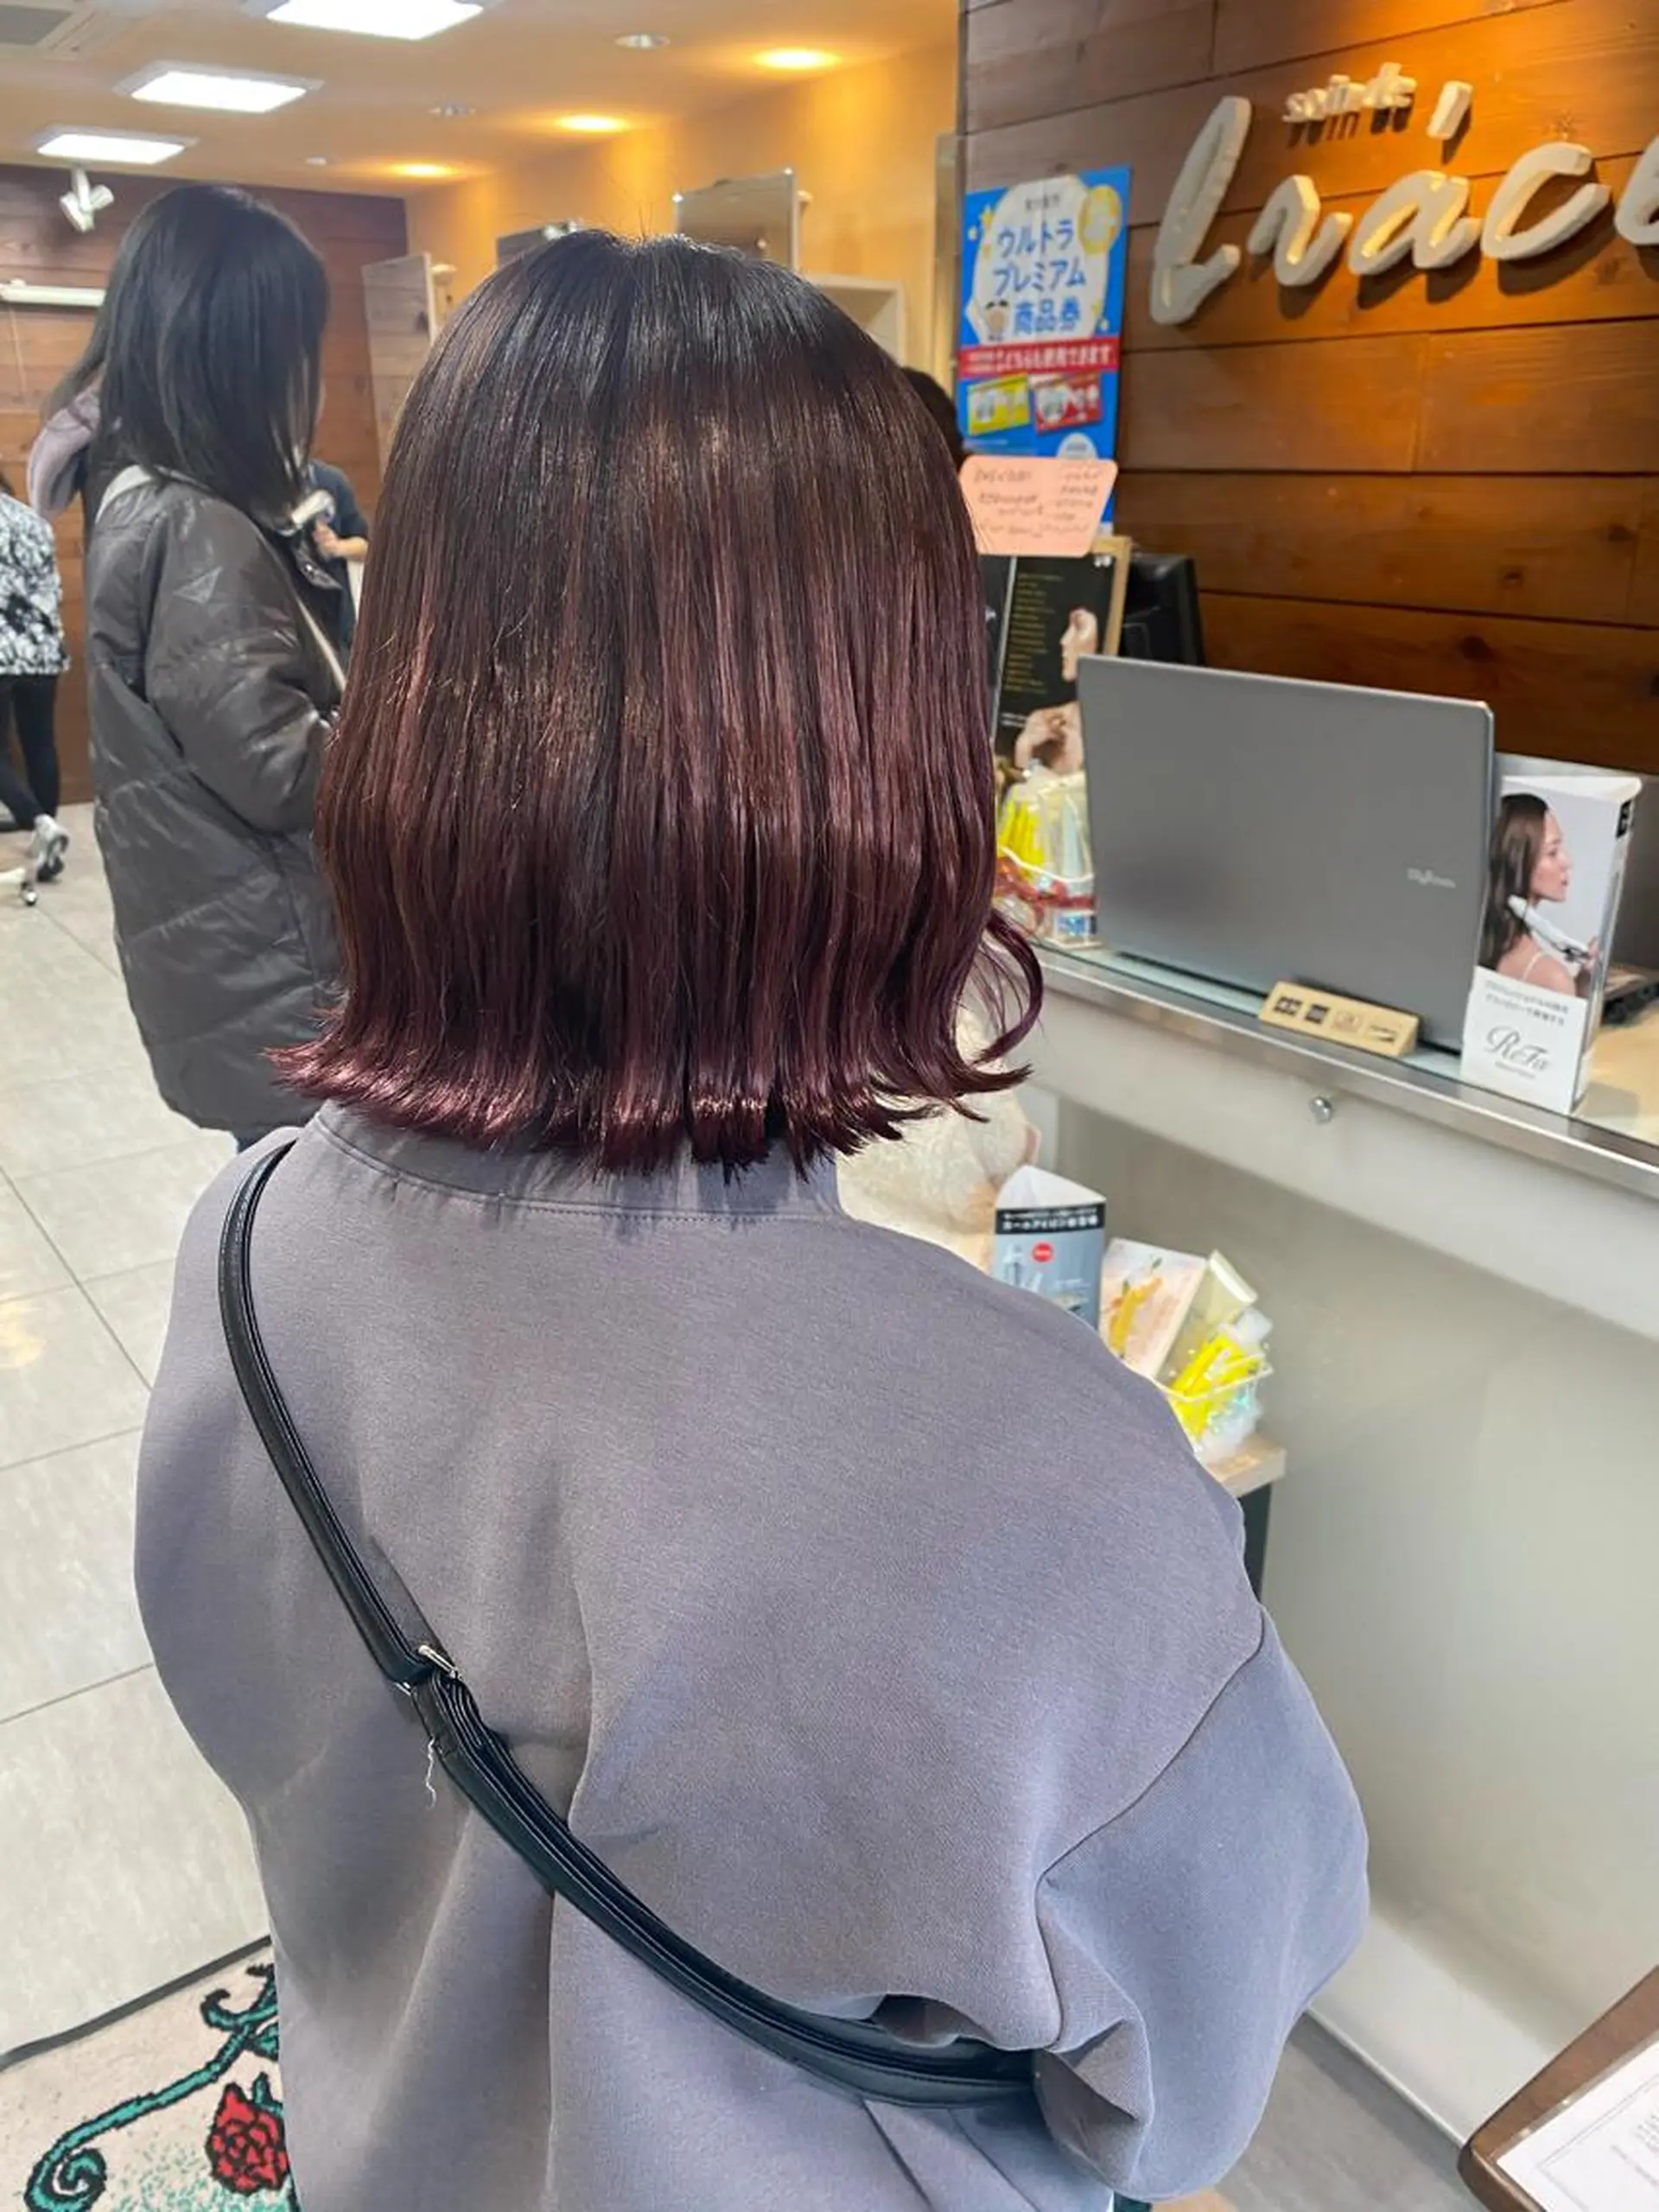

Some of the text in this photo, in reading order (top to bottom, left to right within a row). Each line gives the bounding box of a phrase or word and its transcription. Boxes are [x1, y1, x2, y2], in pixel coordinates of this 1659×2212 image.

[996, 218, 1074, 258] ウルトラ
[992, 260, 1086, 296] プレミアム
